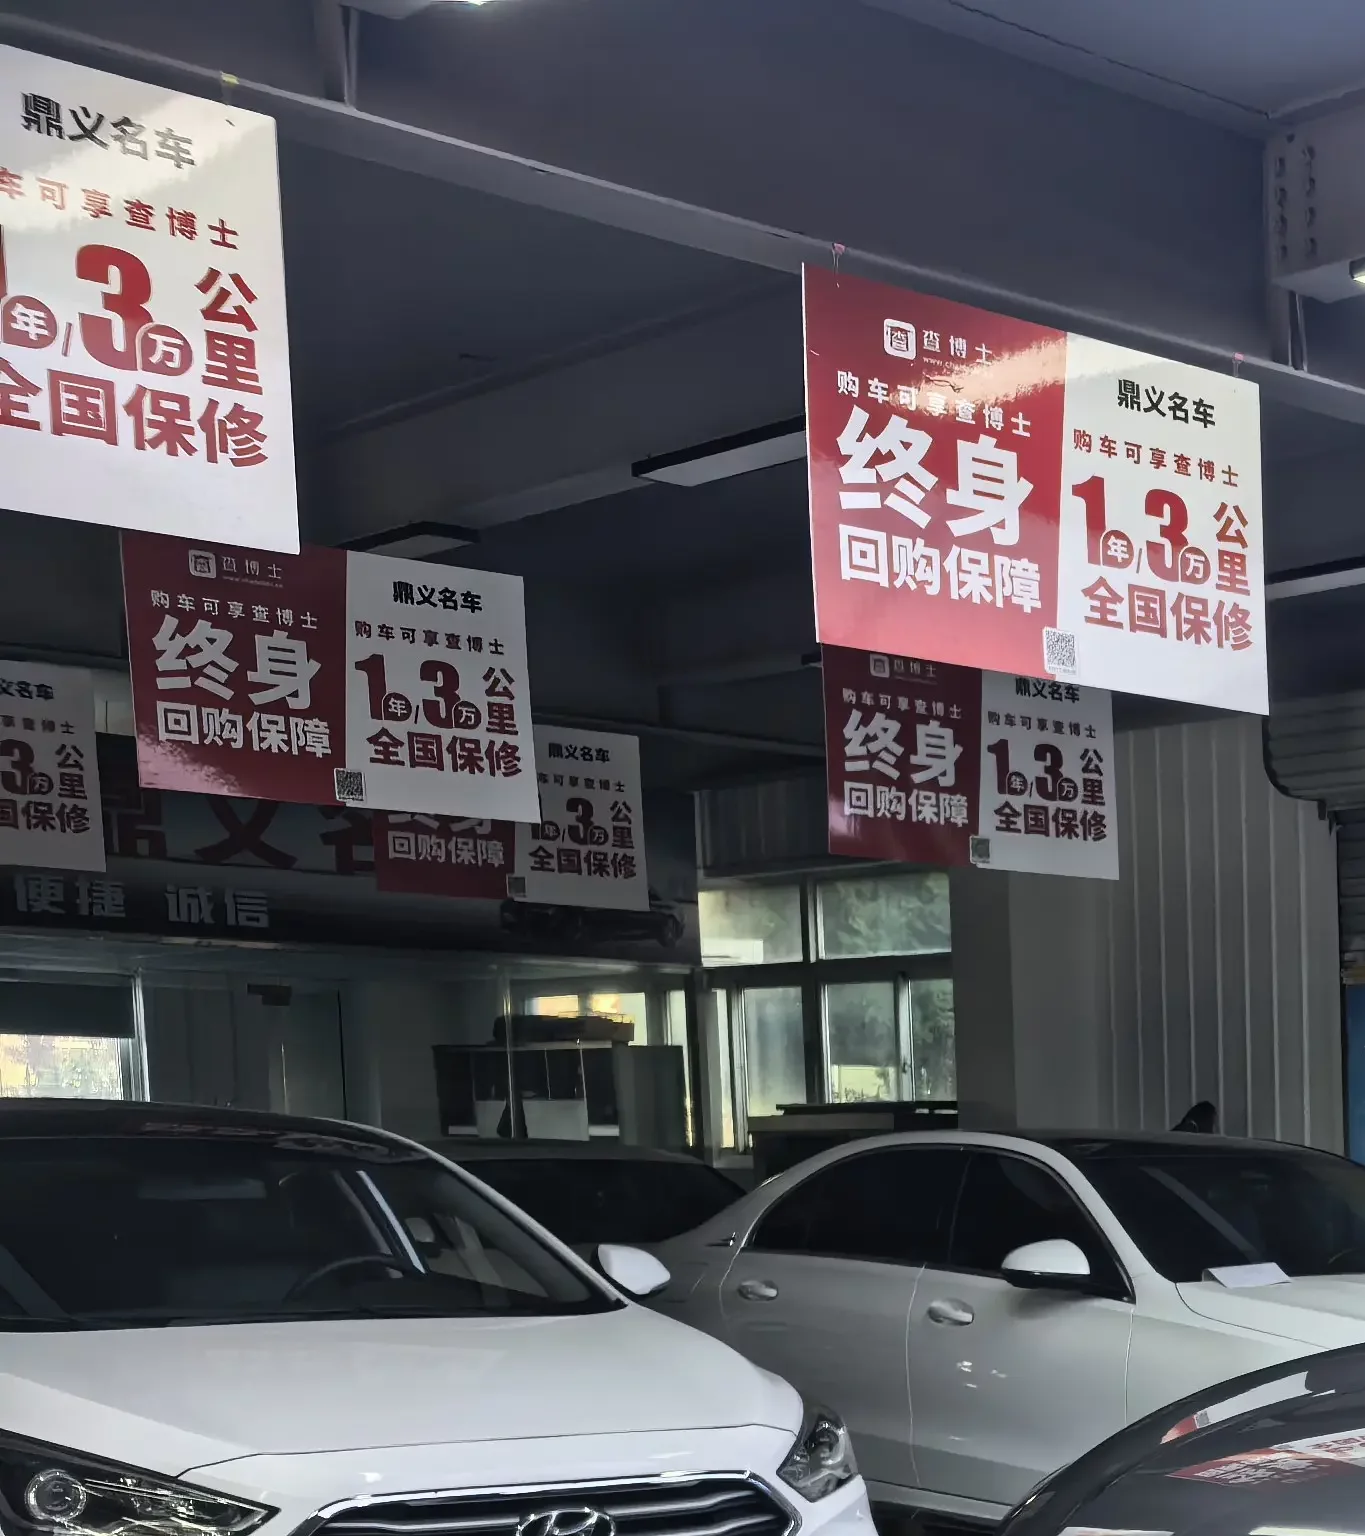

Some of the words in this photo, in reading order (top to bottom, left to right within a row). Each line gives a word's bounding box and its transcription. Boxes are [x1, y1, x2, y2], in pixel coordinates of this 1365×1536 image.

[20, 91, 196, 170] 鼎义名车
[0, 355, 269, 468] 全国保修
[837, 370, 1031, 438] 购车可享查博士
[1117, 378, 1216, 430] 鼎义名车
[836, 404, 1034, 547] 终身
[1072, 428, 1239, 489] 购车可享查博士
[838, 523, 1042, 614] 回购保障
[151, 590, 318, 630] 购车可享查博士
[393, 581, 483, 614] 鼎义名车
[1082, 575, 1255, 652] 全国保修
[152, 614, 322, 710] 终身
[354, 620, 505, 656] 购车可享查博士
[157, 700, 332, 759] 回购保障
[366, 727, 522, 778] 全国保修
[842, 708, 964, 788] 终身
[843, 780, 969, 828] 回购保障
[993, 800, 1107, 842] 全国保修
[387, 830, 505, 869] 回购保障
[529, 844, 637, 880] 全国保修
[165, 884, 270, 928] 诚信
